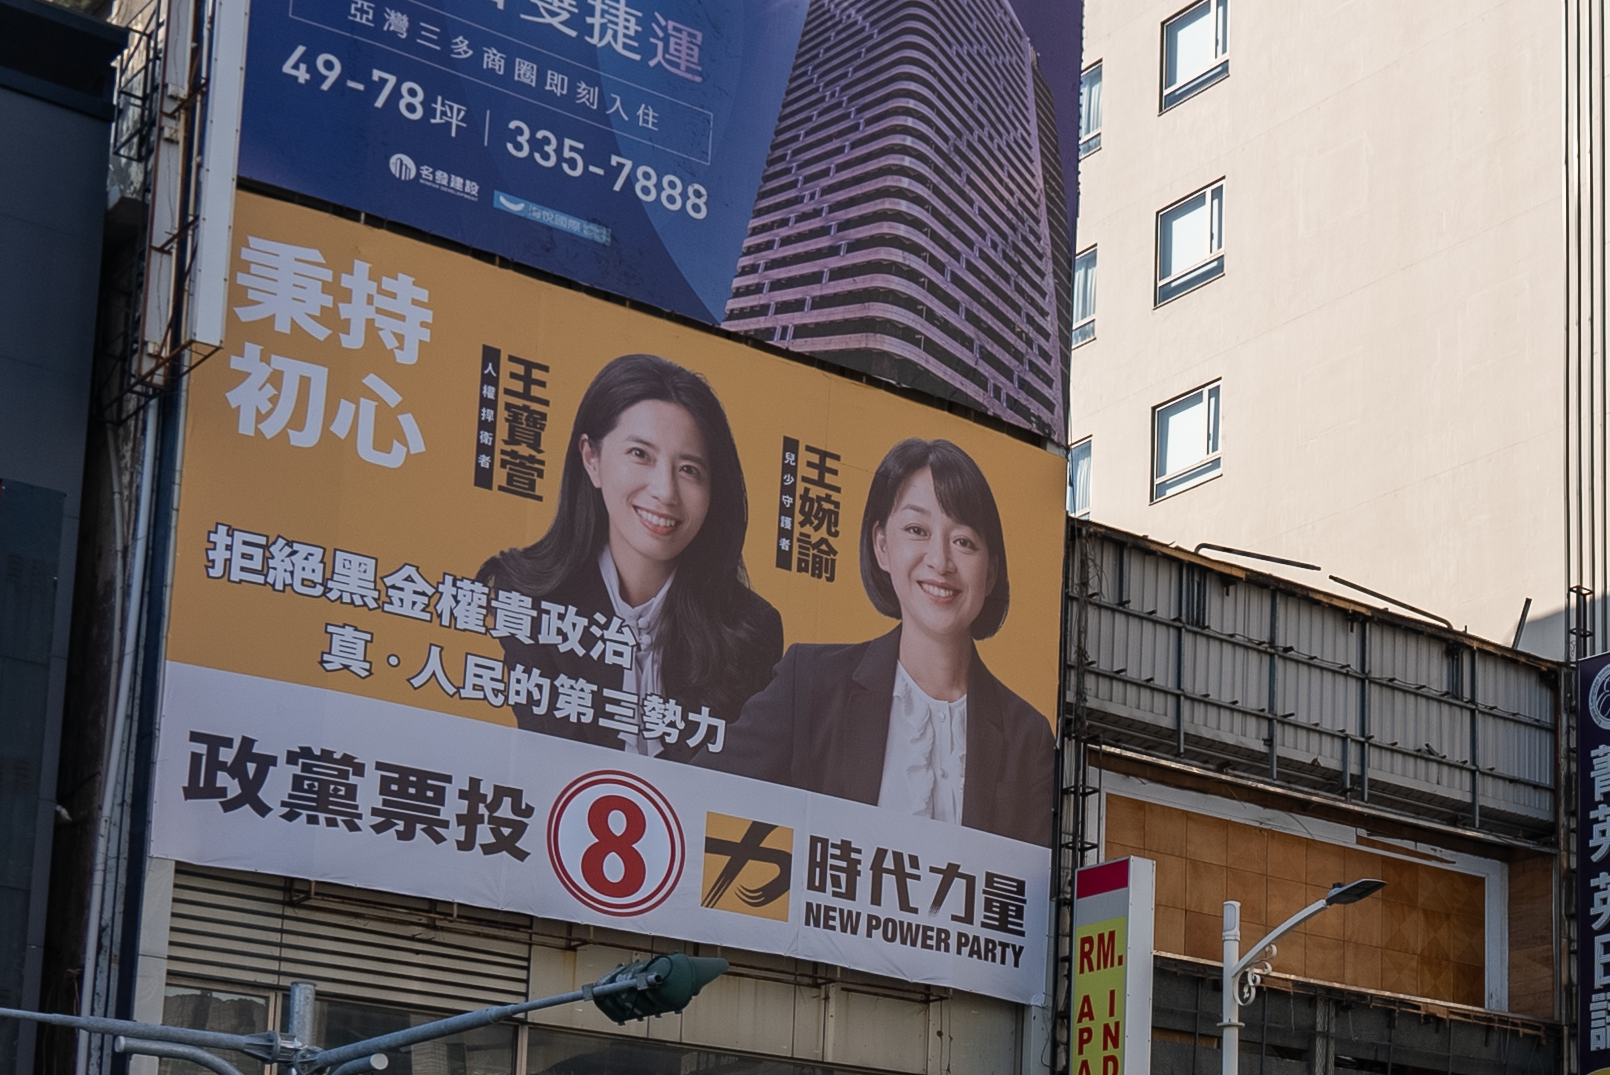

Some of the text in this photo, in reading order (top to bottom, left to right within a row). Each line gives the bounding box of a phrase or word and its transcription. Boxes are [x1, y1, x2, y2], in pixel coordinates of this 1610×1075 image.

[348, 0, 660, 131] 亞灣三多商圈即刻入住
[282, 45, 708, 220] 49-78坪 335-7888
[419, 164, 480, 196] 名發建設
[233, 235, 434, 366] 秉持
[225, 341, 427, 469] 初心
[477, 361, 498, 470] 人權捍衛者
[497, 354, 550, 503] 王寶萱
[779, 450, 797, 552] 兒少守護者
[796, 443, 842, 584] 王婉諭
[205, 522, 638, 671] 拒絕黑金權貴政治
[182, 730, 647, 898] 政黨票投 8
[804, 901, 1025, 969] NEW POWER PARTY
[806, 834, 1027, 938] 時代力量
[1079, 930, 1124, 975] RM.
